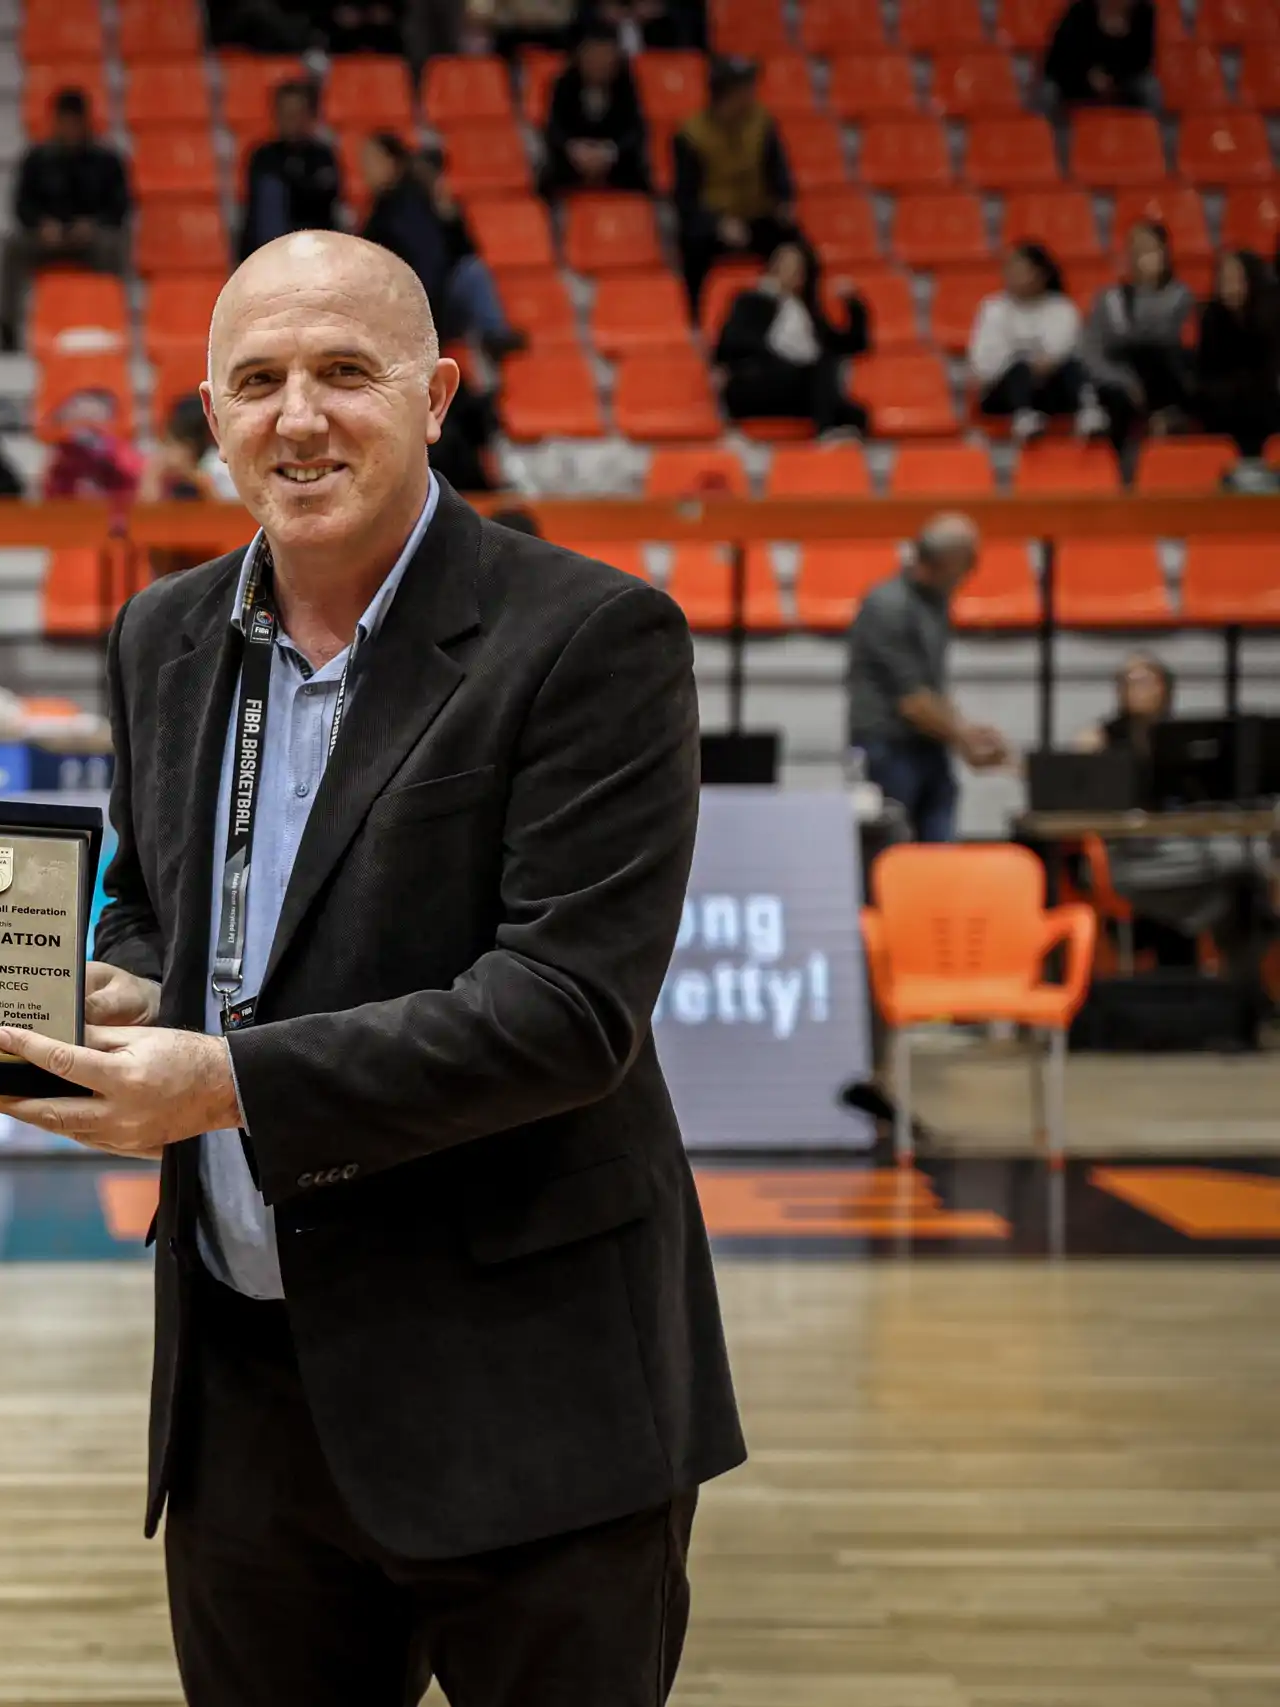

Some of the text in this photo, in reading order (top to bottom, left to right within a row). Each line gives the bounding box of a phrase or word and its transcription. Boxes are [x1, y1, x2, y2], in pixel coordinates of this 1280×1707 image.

[234, 698, 263, 836] FIBA.BASKETBALL
[11, 905, 67, 916] Federation
[27, 1002, 42, 1010] the
[3, 1010, 50, 1021] Potential
